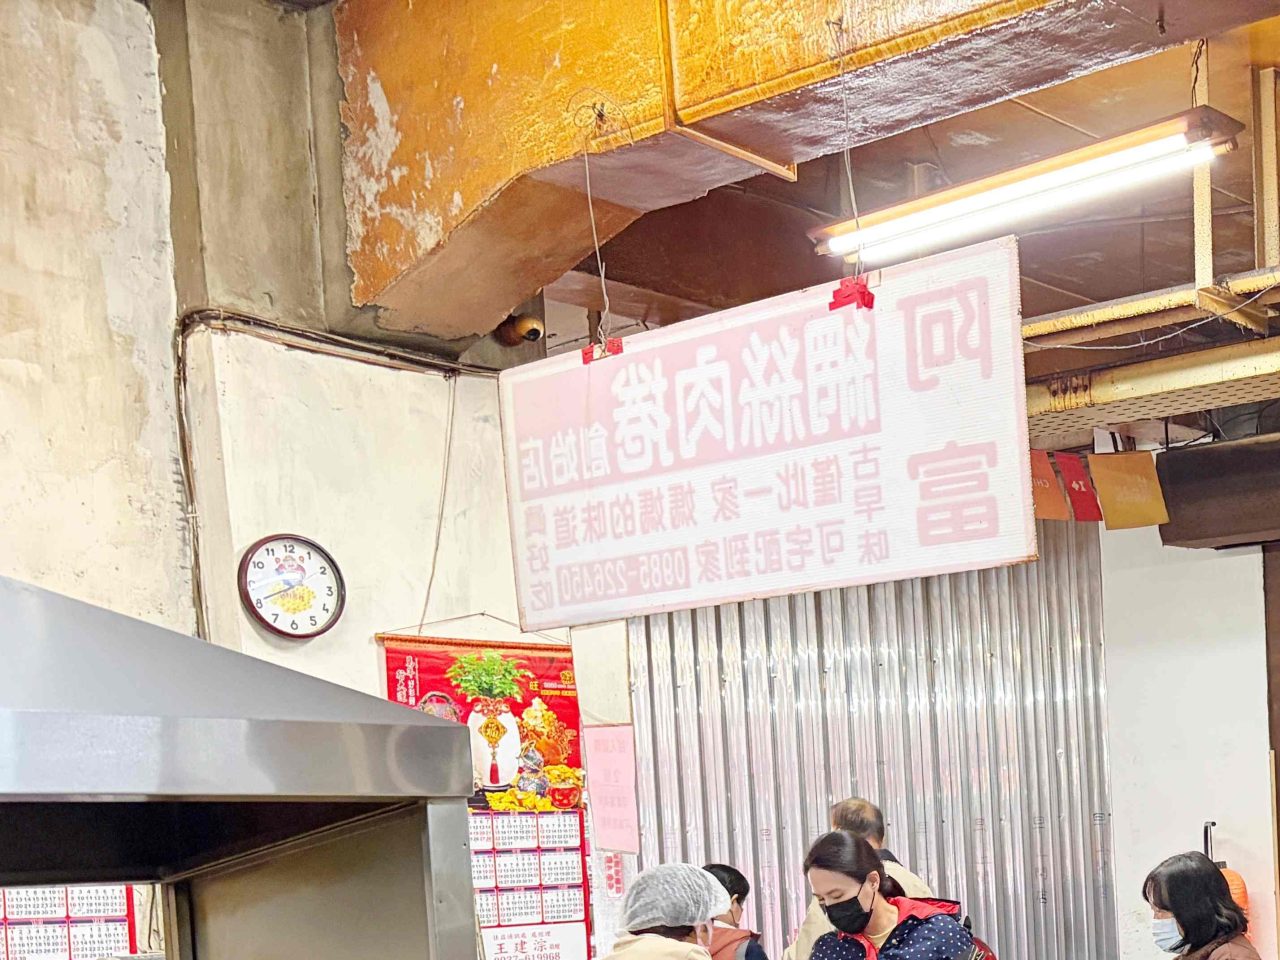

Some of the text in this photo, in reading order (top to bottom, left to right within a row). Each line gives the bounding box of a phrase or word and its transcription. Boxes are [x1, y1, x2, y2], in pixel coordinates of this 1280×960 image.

[265, 548, 275, 556] 11
[284, 544, 295, 554] 12
[307, 552, 311, 560] 1
[252, 561, 264, 569] 10
[320, 566, 327, 575] 2
[326, 586, 333, 596] 3
[256, 598, 263, 609] 8
[322, 603, 329, 614] 4
[272, 614, 279, 623] 7
[310, 616, 317, 626] 5
[290, 620, 298, 630] 6
